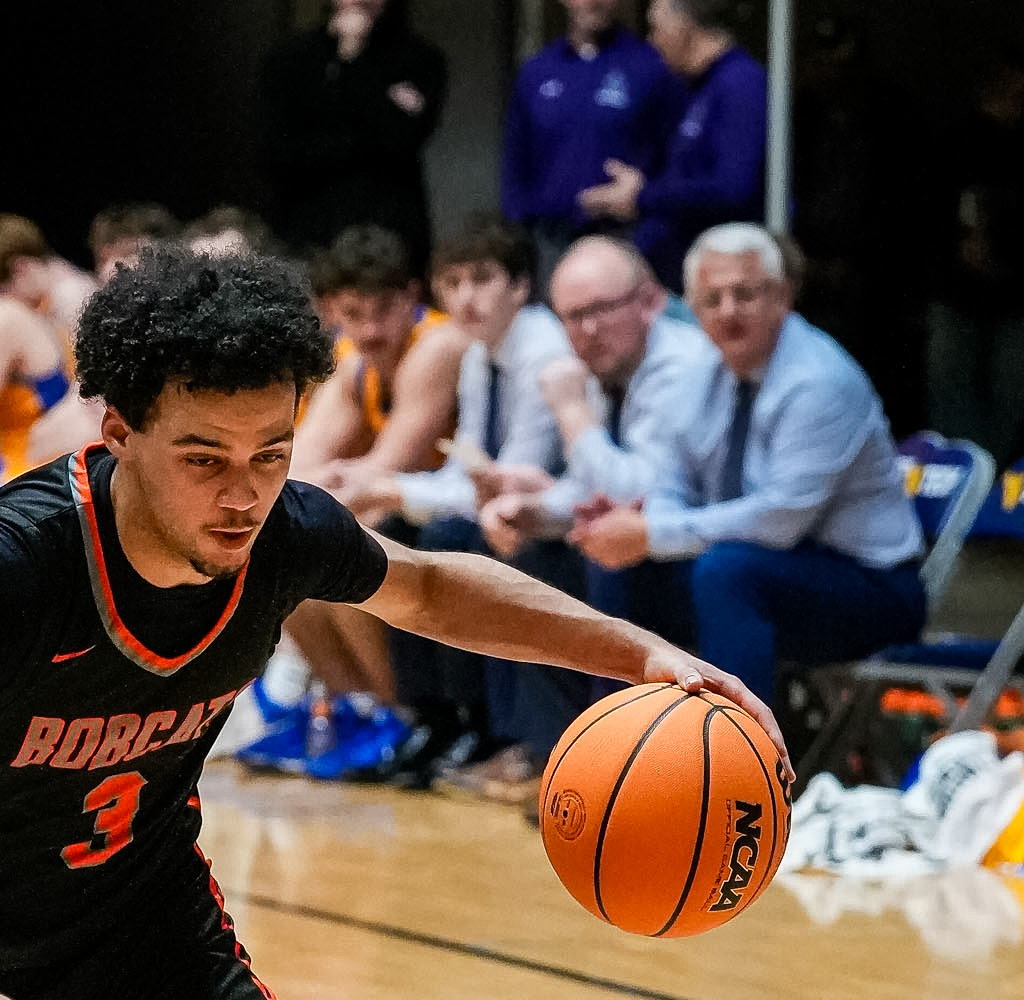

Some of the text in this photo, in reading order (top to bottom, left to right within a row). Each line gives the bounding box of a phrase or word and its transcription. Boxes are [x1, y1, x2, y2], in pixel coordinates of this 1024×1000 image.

[10, 677, 257, 771] BOBCAT
[60, 771, 149, 869] 3
[707, 799, 762, 912] NCAA
